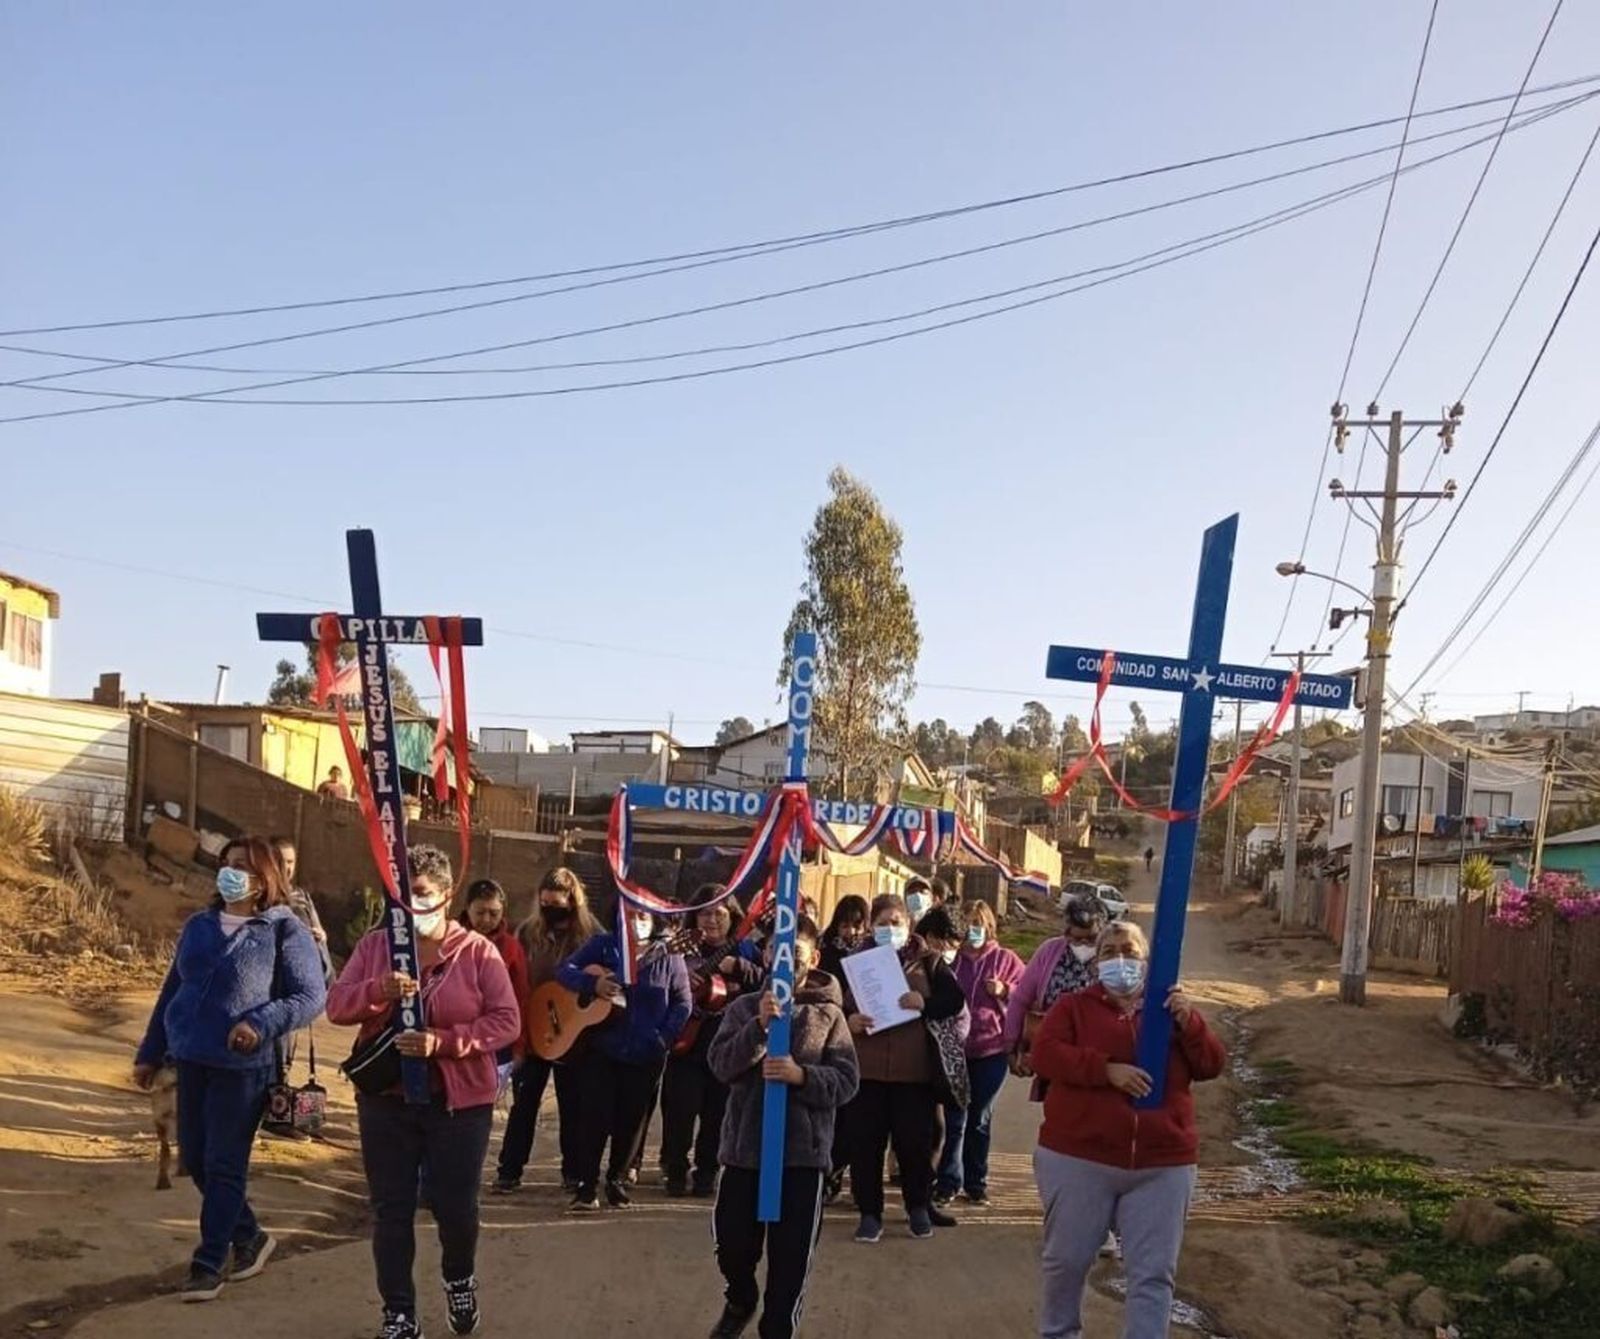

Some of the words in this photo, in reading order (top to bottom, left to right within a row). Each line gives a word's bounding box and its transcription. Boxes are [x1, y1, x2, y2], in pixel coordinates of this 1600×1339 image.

[311, 617, 429, 642] CPILLA
[1162, 666, 1189, 682] SAN
[1217, 672, 1276, 691] ALBERTO
[664, 786, 760, 815] CRISTO
[815, 799, 926, 829] REDETO
[373, 751, 393, 793] EL
[391, 907, 410, 946] DE
